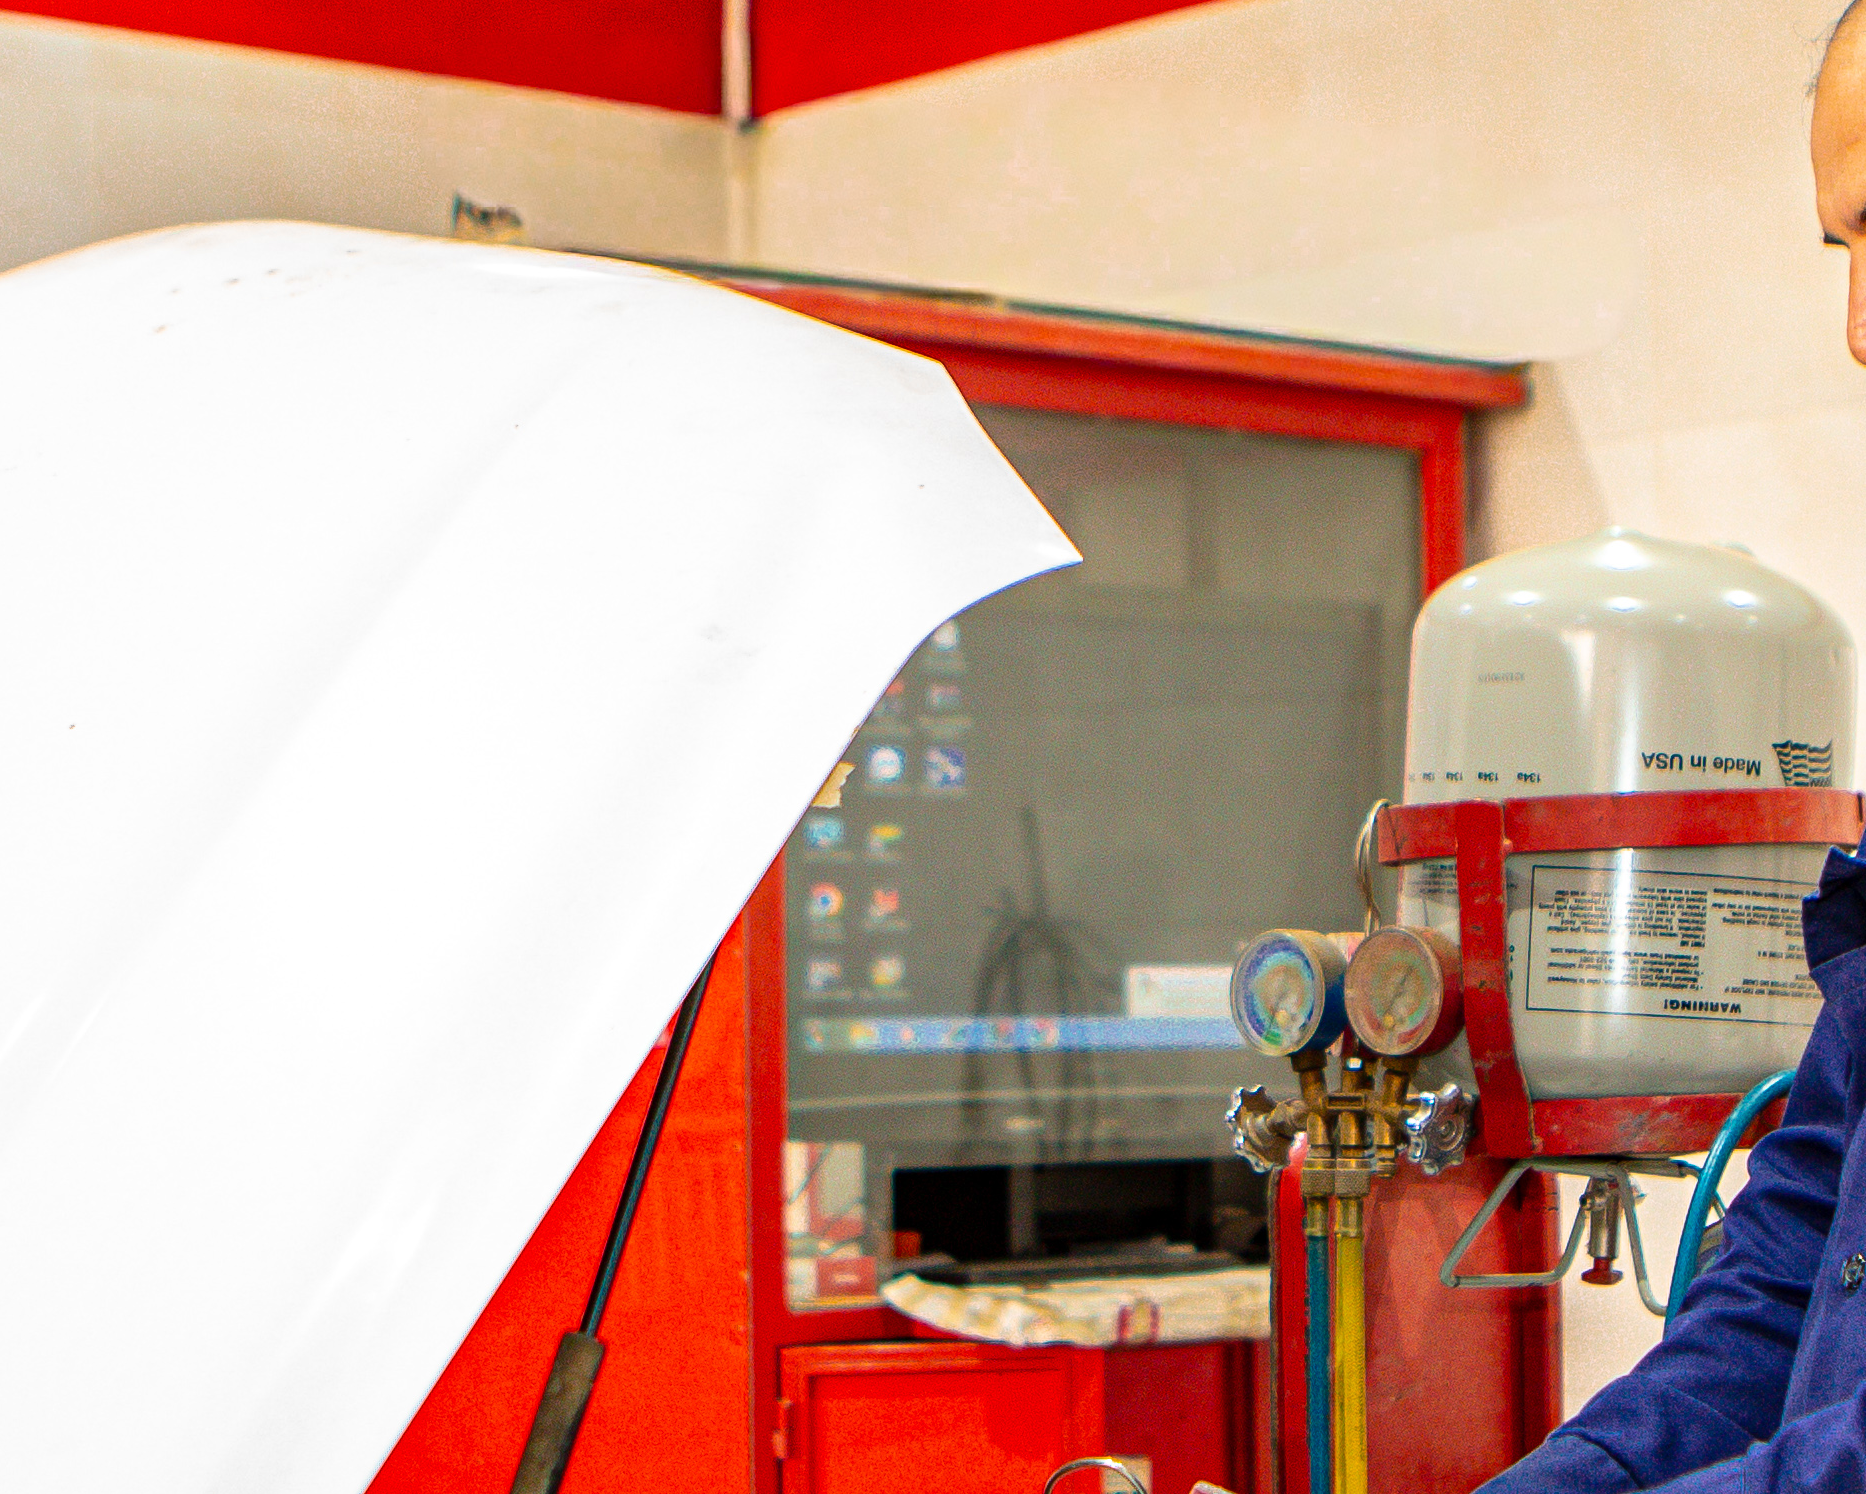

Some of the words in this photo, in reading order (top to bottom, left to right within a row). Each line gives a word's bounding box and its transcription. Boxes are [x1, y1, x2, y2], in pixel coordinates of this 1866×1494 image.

[1641, 752, 1683, 771] USA
[1691, 755, 1707, 772] in
[1713, 756, 1761, 777] Made
[1664, 999, 1741, 1014] WARNING!
